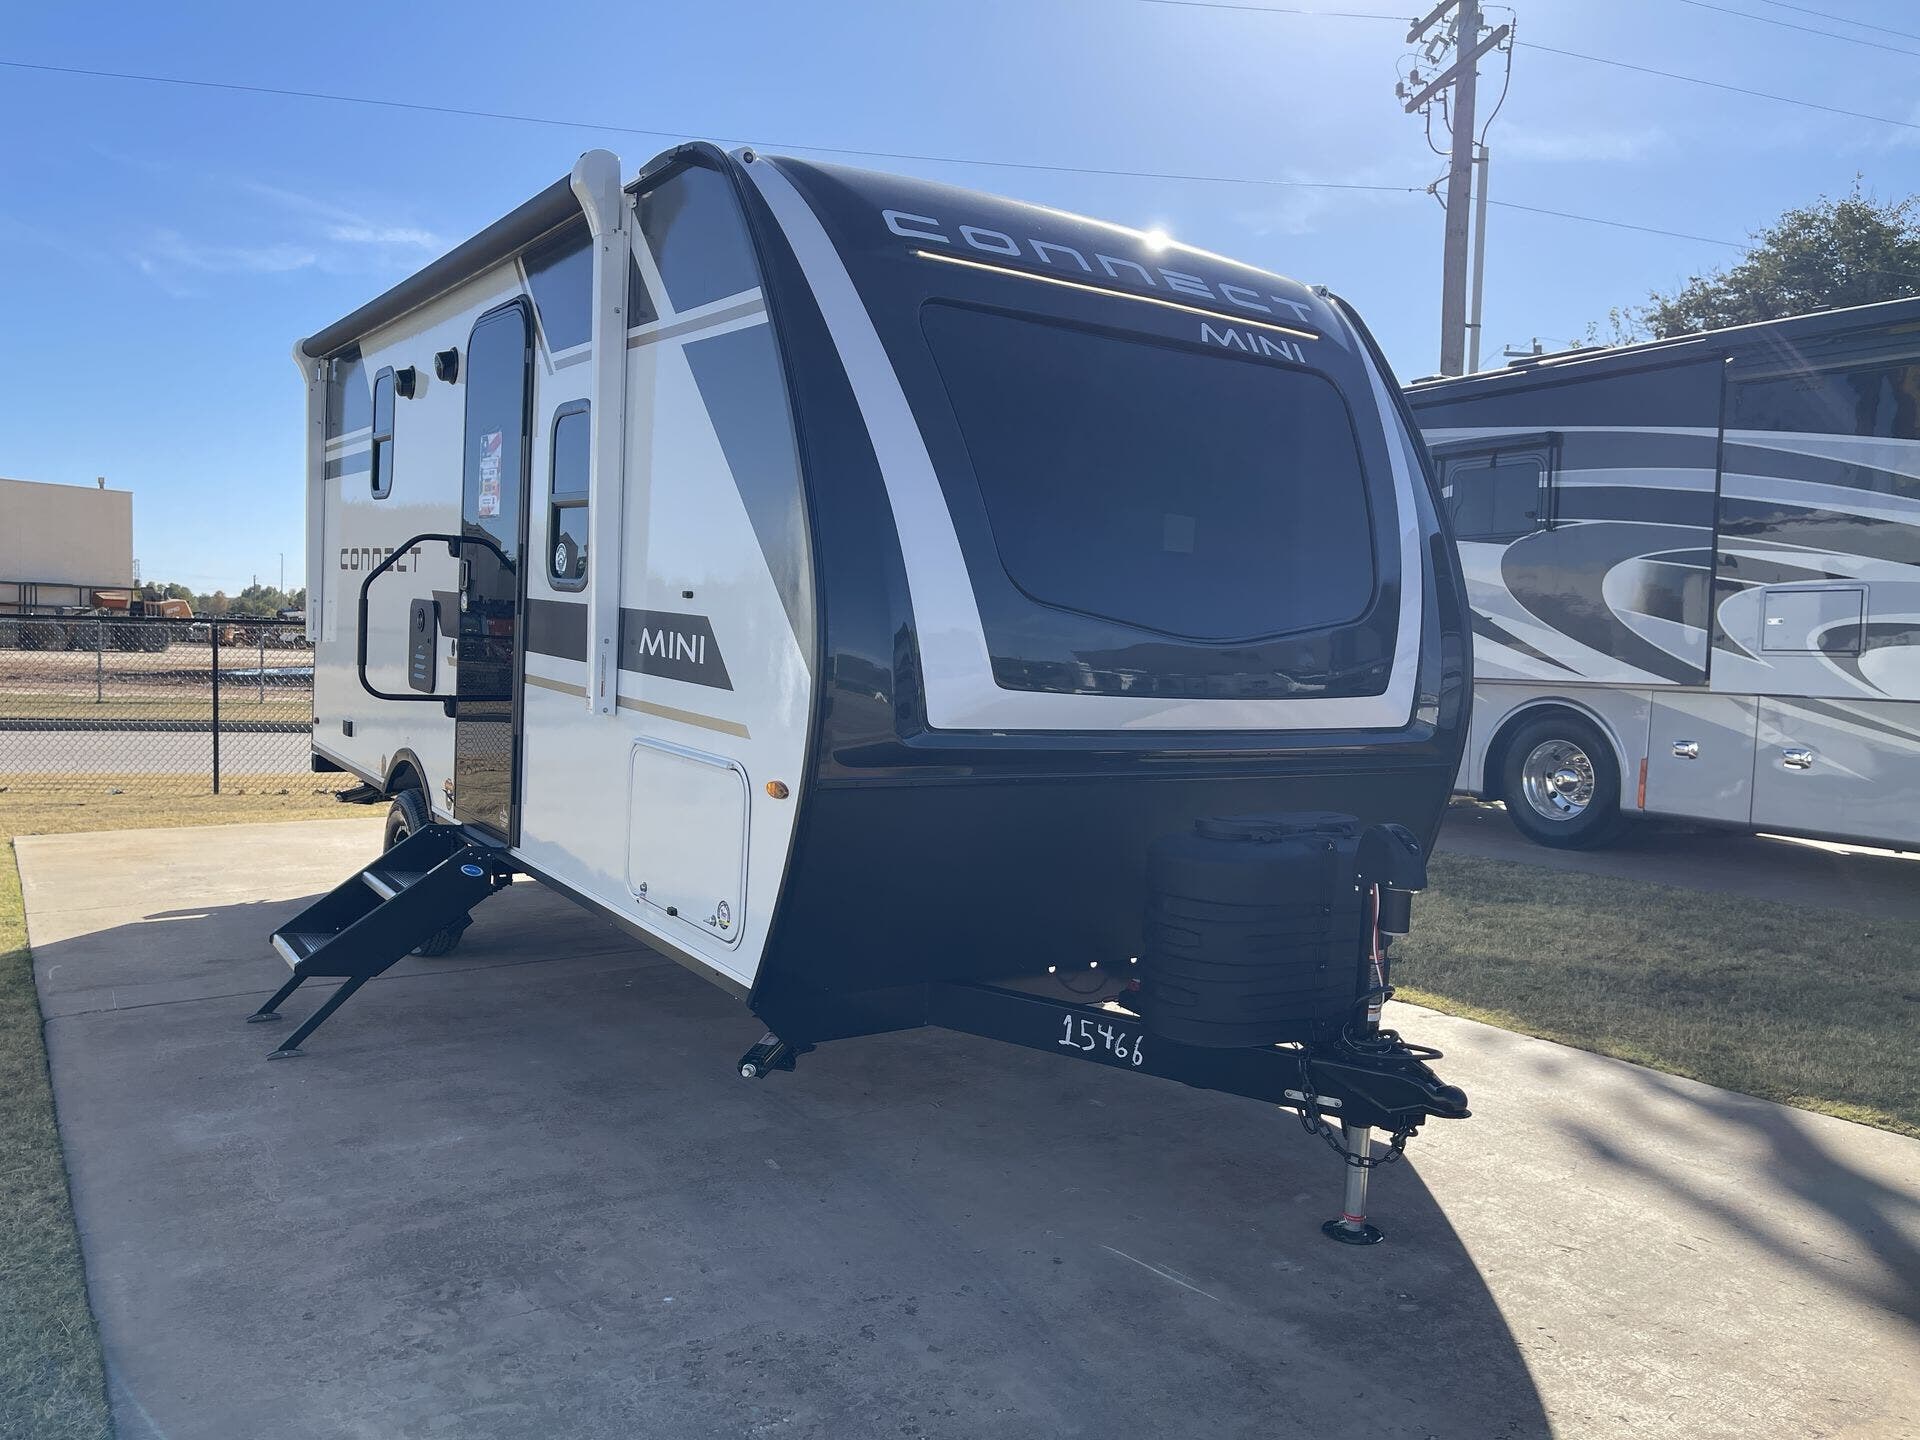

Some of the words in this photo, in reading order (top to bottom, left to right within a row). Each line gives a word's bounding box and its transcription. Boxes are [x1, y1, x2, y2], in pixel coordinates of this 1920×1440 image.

[882, 209, 1312, 323] CONNECT
[1201, 322, 1306, 364] MINI
[639, 627, 705, 665] MINI
[1058, 1014, 1144, 1066] 15466
